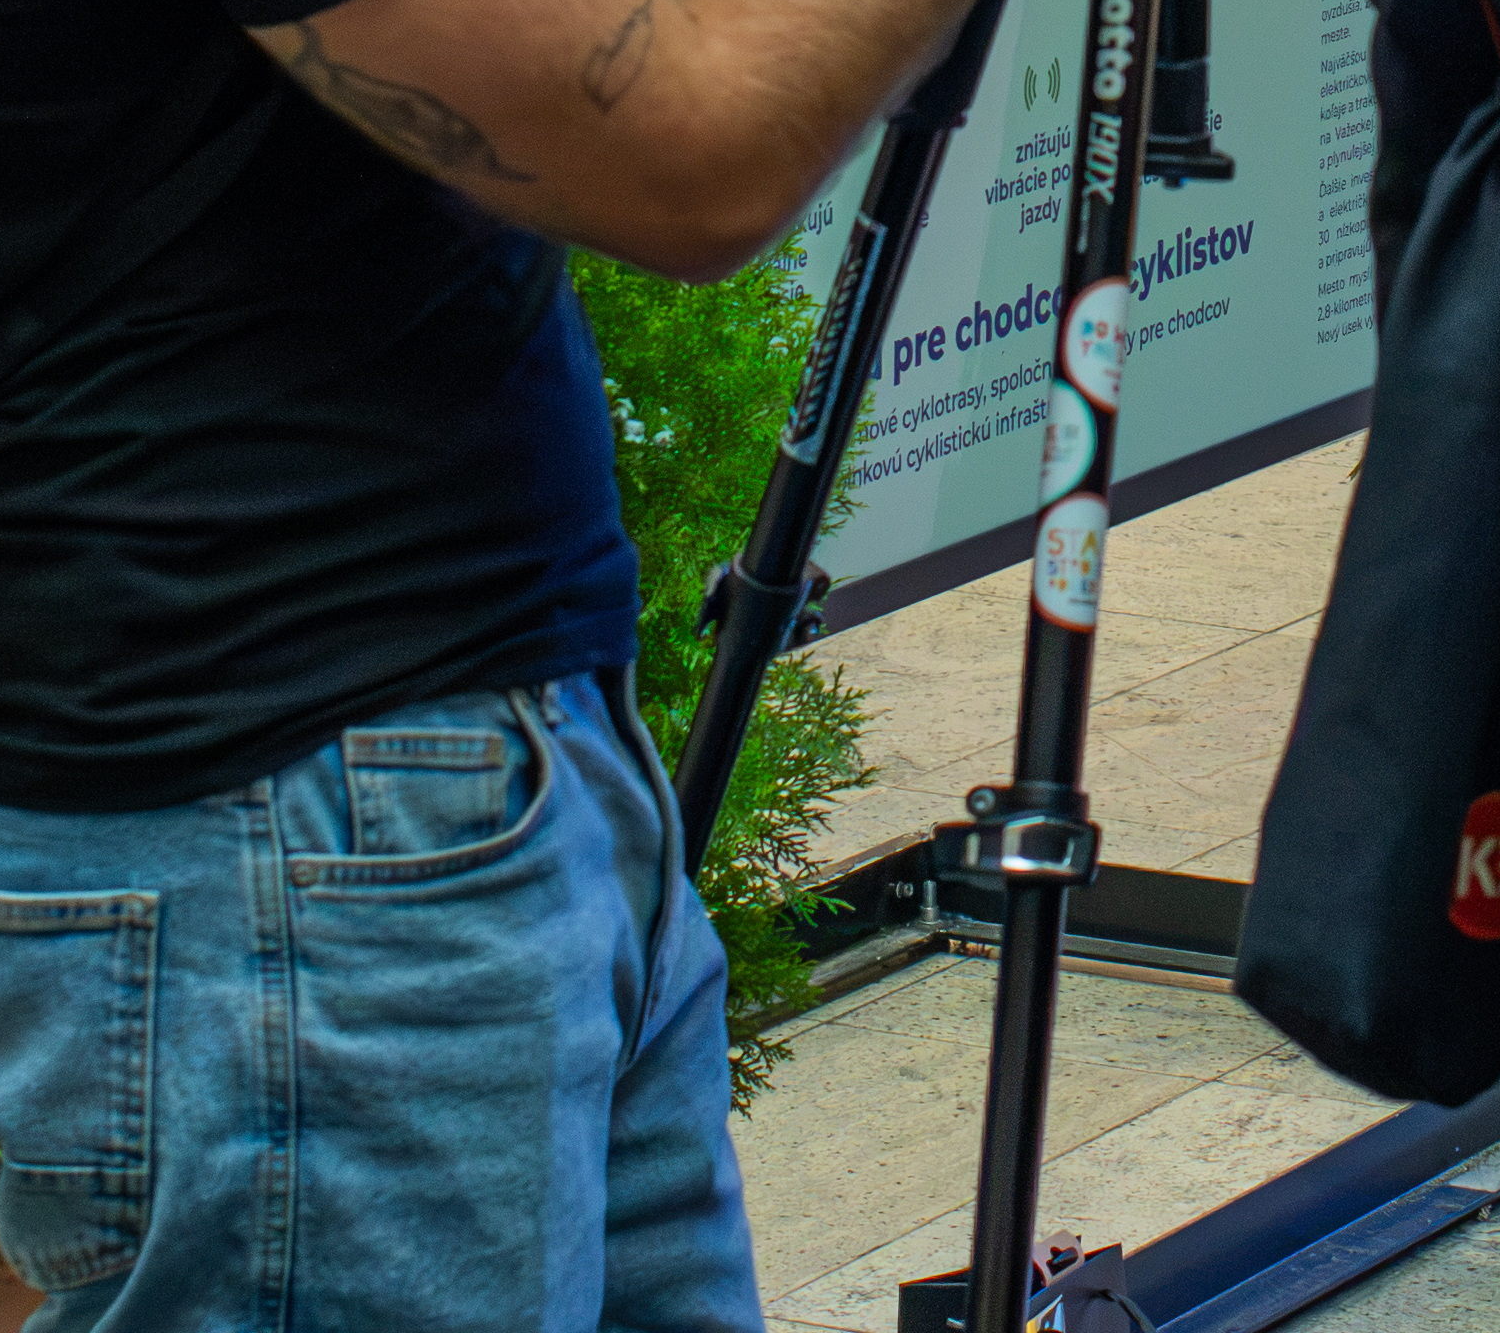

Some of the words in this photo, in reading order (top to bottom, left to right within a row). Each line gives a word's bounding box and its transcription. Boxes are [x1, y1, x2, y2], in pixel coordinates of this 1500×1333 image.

[1015, 125, 1071, 164] znižujú
[985, 166, 1048, 206] vibrácie
[1019, 195, 1062, 233] jazdy
[893, 325, 946, 386] pre
[902, 383, 988, 433] cyklotrasy,
[1139, 321, 1164, 351] pre
[1168, 297, 1231, 335] chodcov
[906, 416, 991, 472] cyklistickú
